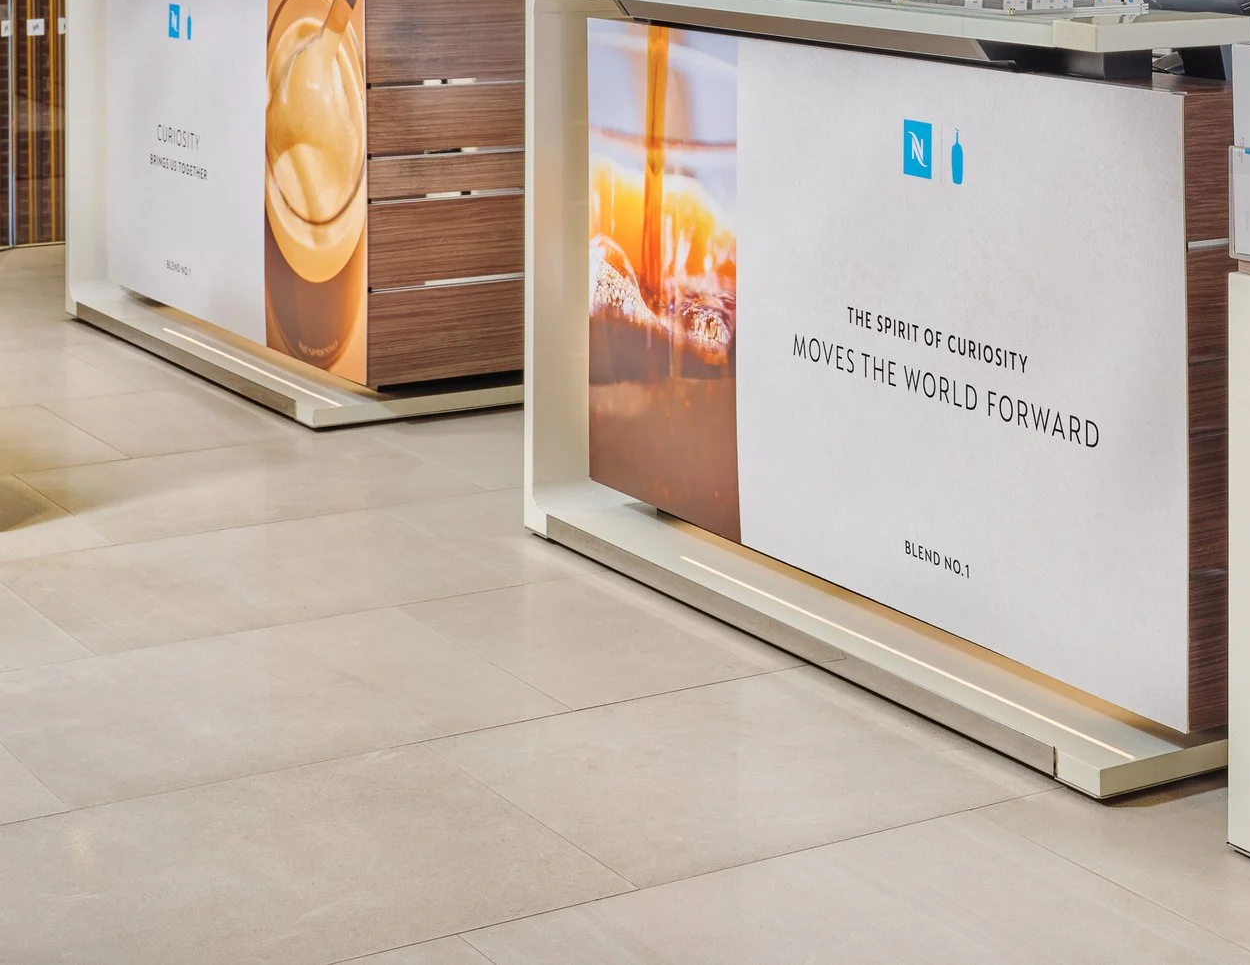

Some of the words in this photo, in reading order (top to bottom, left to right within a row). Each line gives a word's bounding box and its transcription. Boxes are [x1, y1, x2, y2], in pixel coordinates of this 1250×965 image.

[156, 124, 200, 151] CURIOSITY
[907, 130, 929, 168] N
[149, 153, 169, 169] BRINGS
[170, 158, 177, 172] US
[178, 161, 208, 180] TOGETHER
[166, 258, 181, 273] BLEND
[846, 306, 873, 330] THE
[876, 314, 920, 343] SPIRIT
[924, 327, 943, 349] OF
[947, 334, 1028, 374] CURIOSITY
[792, 334, 855, 374] MOVES
[860, 352, 897, 388] THE
[903, 365, 978, 411] WORLD
[987, 390, 1100, 449] FORWARD
[904, 539, 941, 566] BLEND
[944, 555, 970, 579] NO.1
